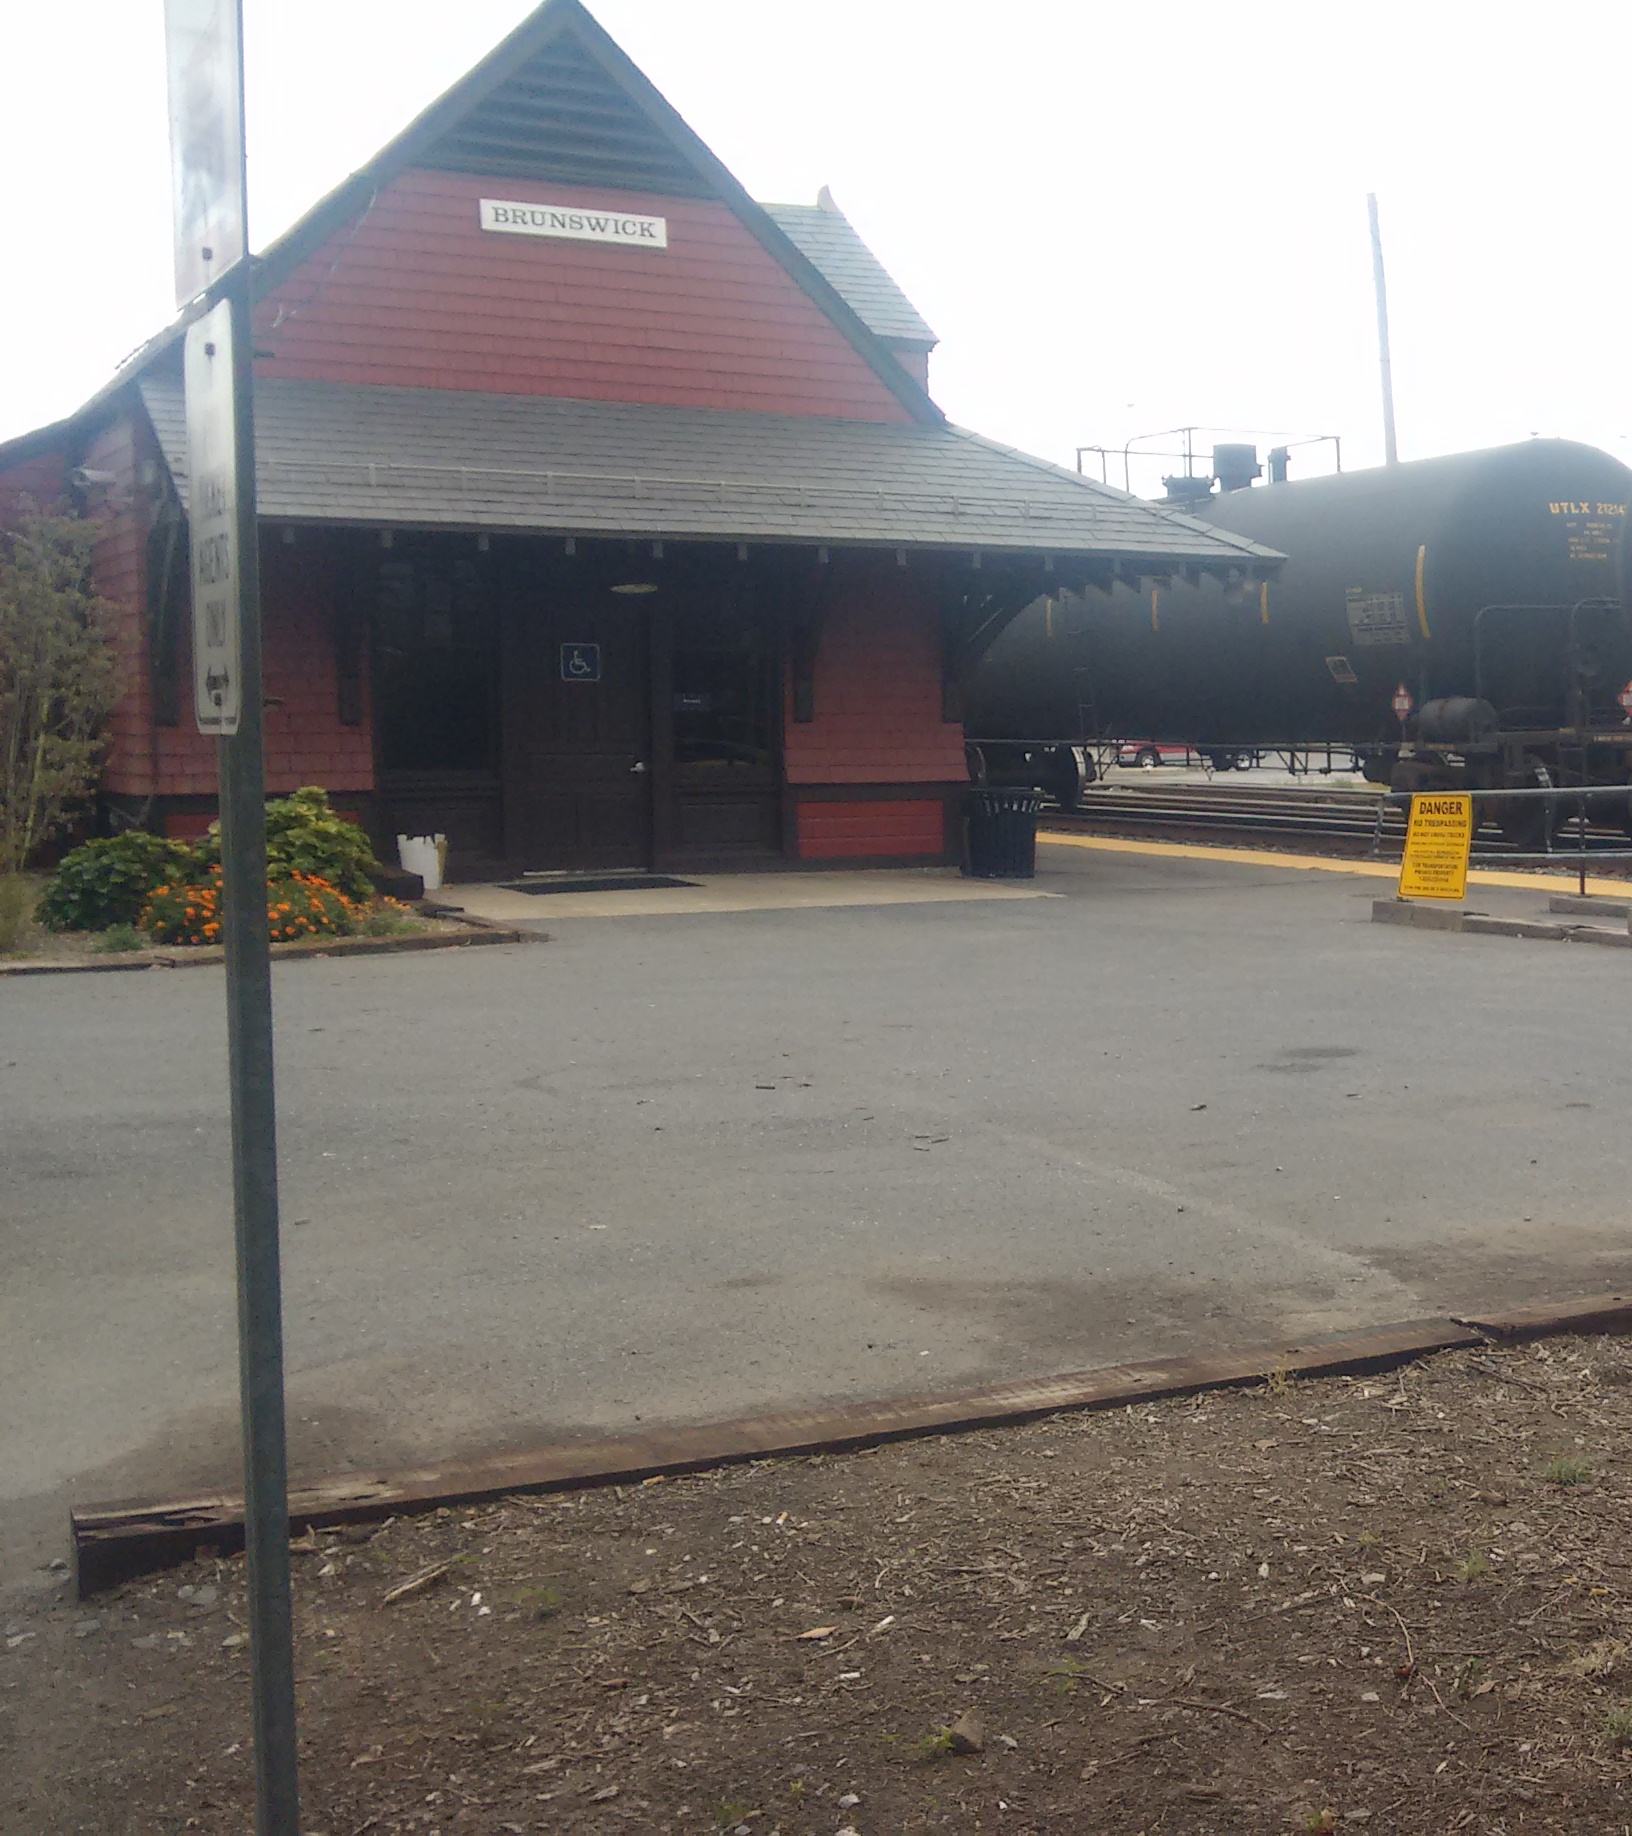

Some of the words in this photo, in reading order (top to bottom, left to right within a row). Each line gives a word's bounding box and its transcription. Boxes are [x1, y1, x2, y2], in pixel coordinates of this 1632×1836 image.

[491, 206, 657, 239] BRUNSWICK
[1549, 502, 1590, 514] UTLX
[1419, 801, 1463, 815] DANGER
[1413, 819, 1423, 827] NO
[1424, 819, 1467, 828] TRESPASSING
